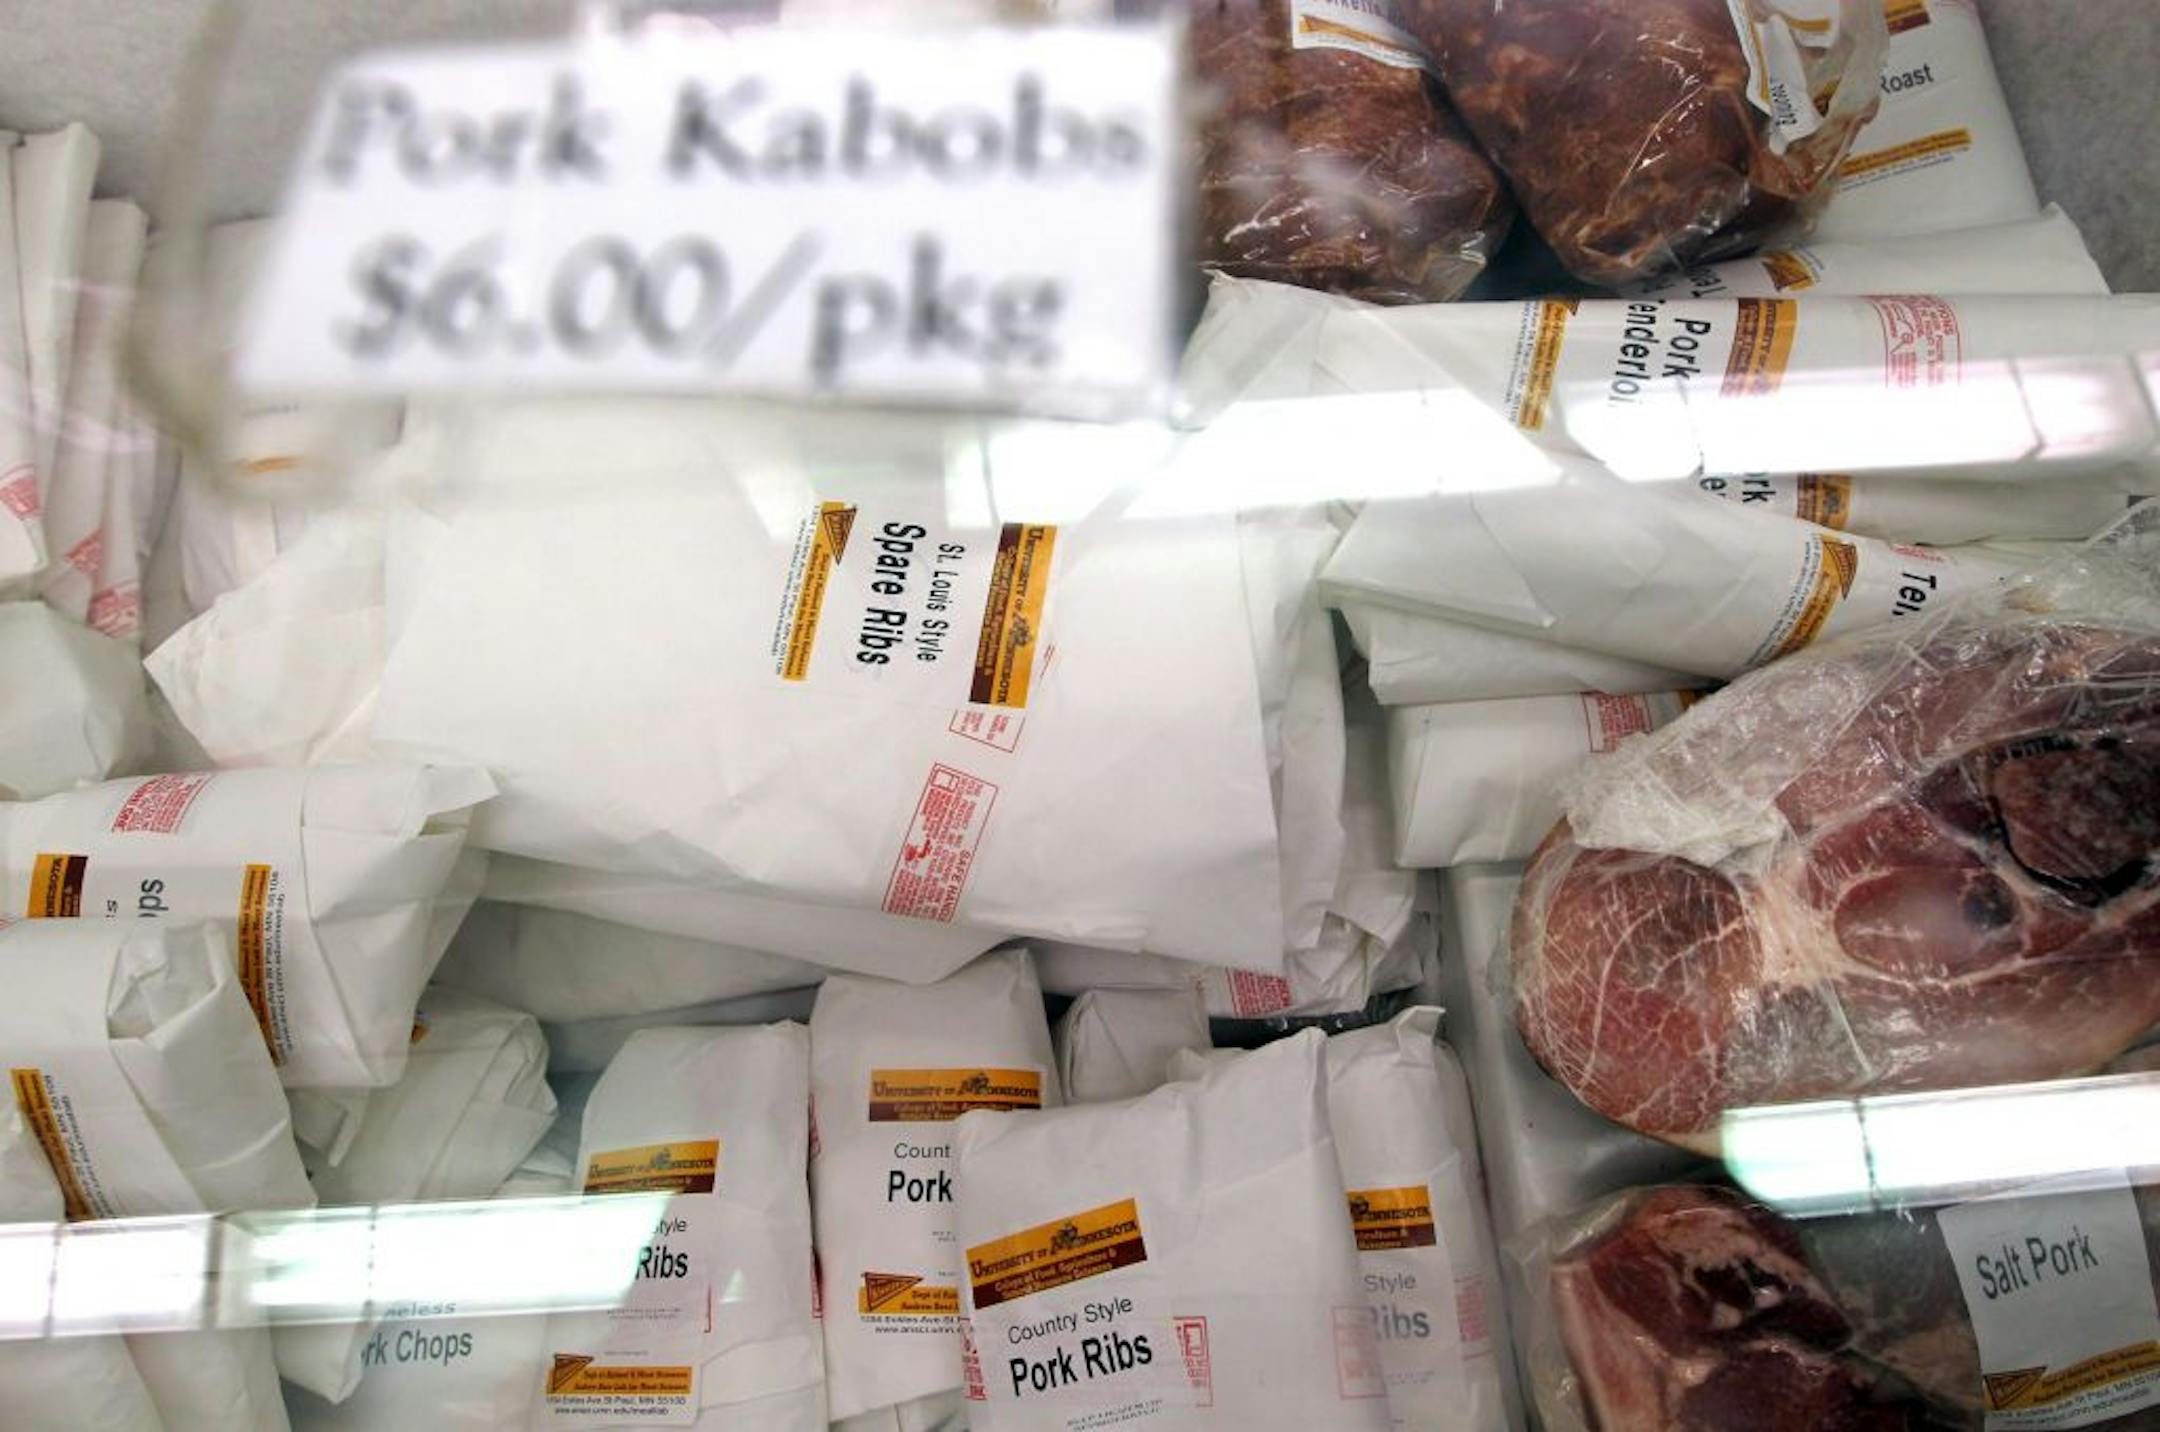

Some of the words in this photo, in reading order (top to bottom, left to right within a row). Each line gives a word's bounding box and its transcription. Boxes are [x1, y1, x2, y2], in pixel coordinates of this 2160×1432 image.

[323, 66, 612, 190] Pork
[662, 70, 1153, 185] Kabobs
[331, 228, 1065, 392] $6.00/pkg
[1609, 298, 1661, 406] enderloi
[1662, 318, 1711, 381] Pork
[1742, 472, 1777, 503] rk
[870, 521, 926, 596] Spare
[938, 543, 966, 563] St.
[930, 569, 959, 613] Louis
[856, 607, 907, 666] Ribs
[917, 618, 950, 662] Style
[894, 1143, 952, 1159] Count
[888, 1170, 954, 1202] Pork
[652, 1218, 688, 1235] tyle
[635, 1245, 689, 1281] Ribs
[1364, 1273, 1417, 1293] Style
[1976, 1244, 2029, 1300] Salt
[2025, 1228, 2099, 1280] Pork
[384, 1301, 457, 1317] neless
[1008, 1312, 1078, 1344] Country
[1083, 1296, 1134, 1324] Style
[361, 1334, 387, 1367] rk
[395, 1330, 473, 1366] Chops
[1010, 1345, 1078, 1397] Pork
[1081, 1331, 1153, 1379] Ribs
